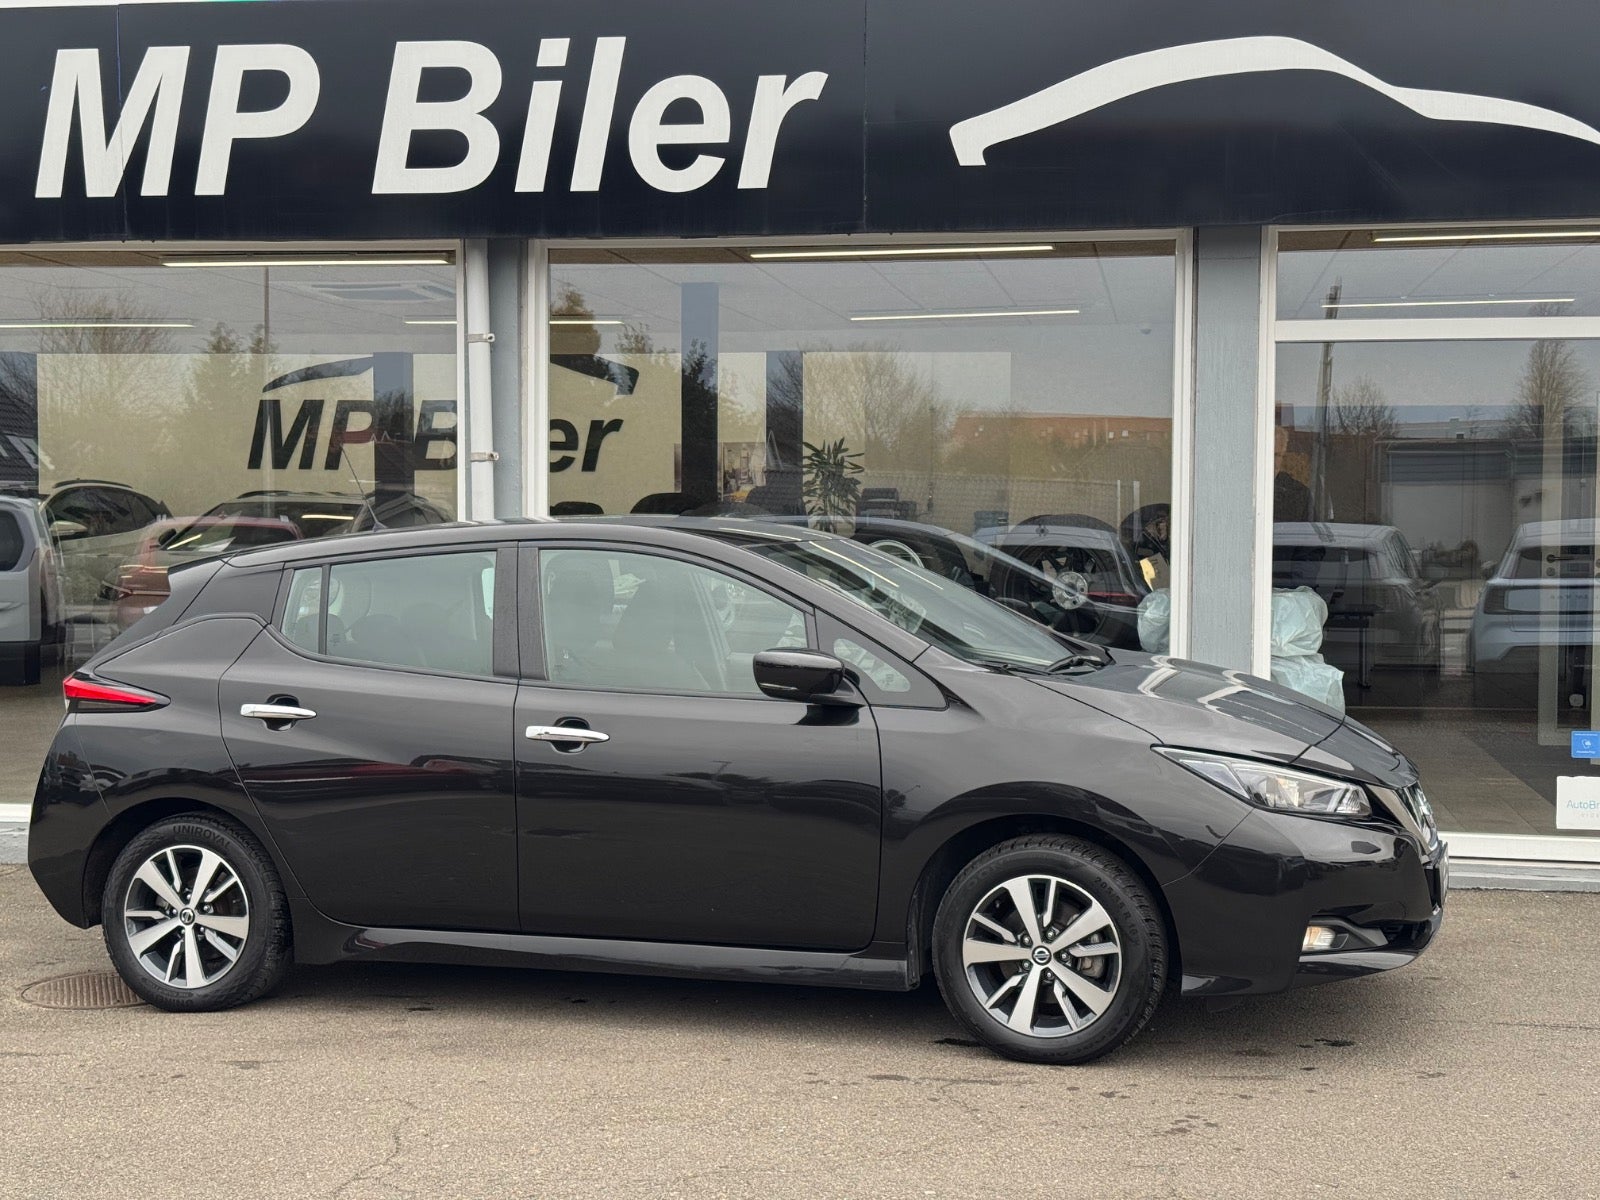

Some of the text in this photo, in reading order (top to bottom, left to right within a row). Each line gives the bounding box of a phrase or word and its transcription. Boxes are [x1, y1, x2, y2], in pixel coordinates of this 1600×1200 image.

[35, 36, 828, 199] MP Biler
[247, 399, 375, 470] MP
[173, 825, 231, 849] UNIROYAL
